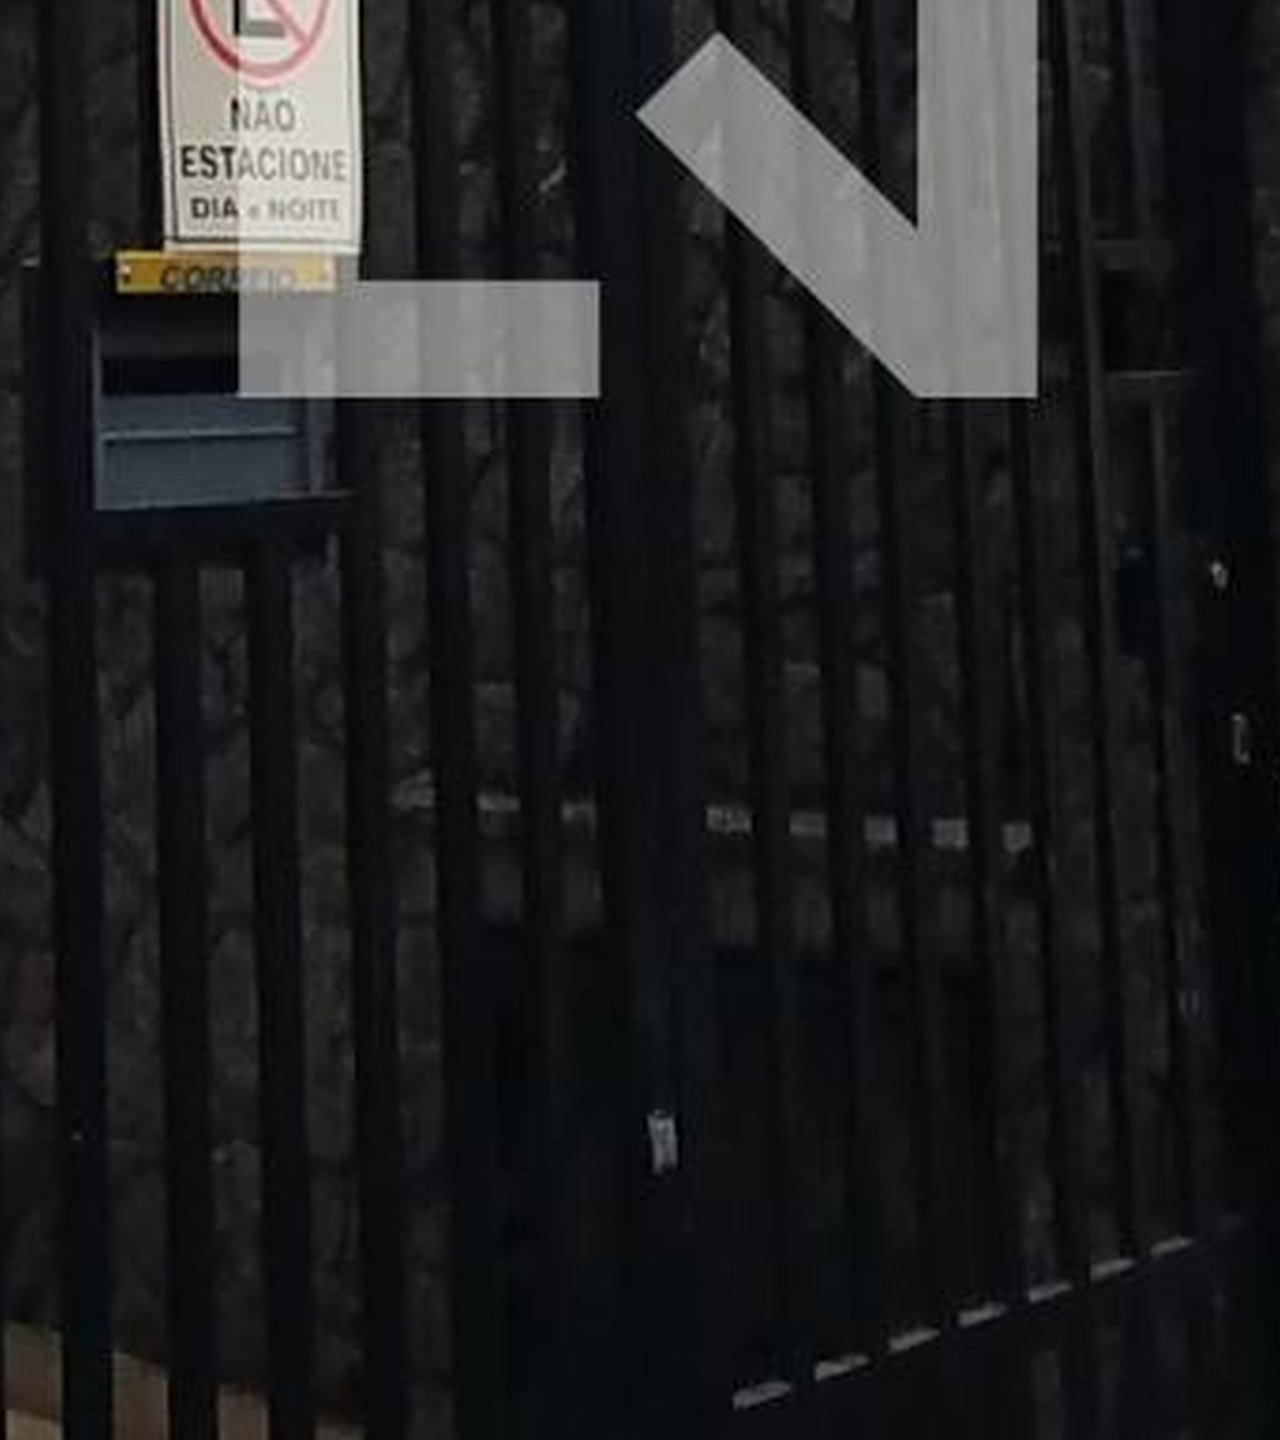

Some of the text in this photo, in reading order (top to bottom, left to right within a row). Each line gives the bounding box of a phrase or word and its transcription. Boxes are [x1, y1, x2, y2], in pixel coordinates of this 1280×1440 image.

[180, 144, 348, 182] ESTACIONE
[190, 196, 239, 219] DIA
[270, 197, 340, 220] NOITE
